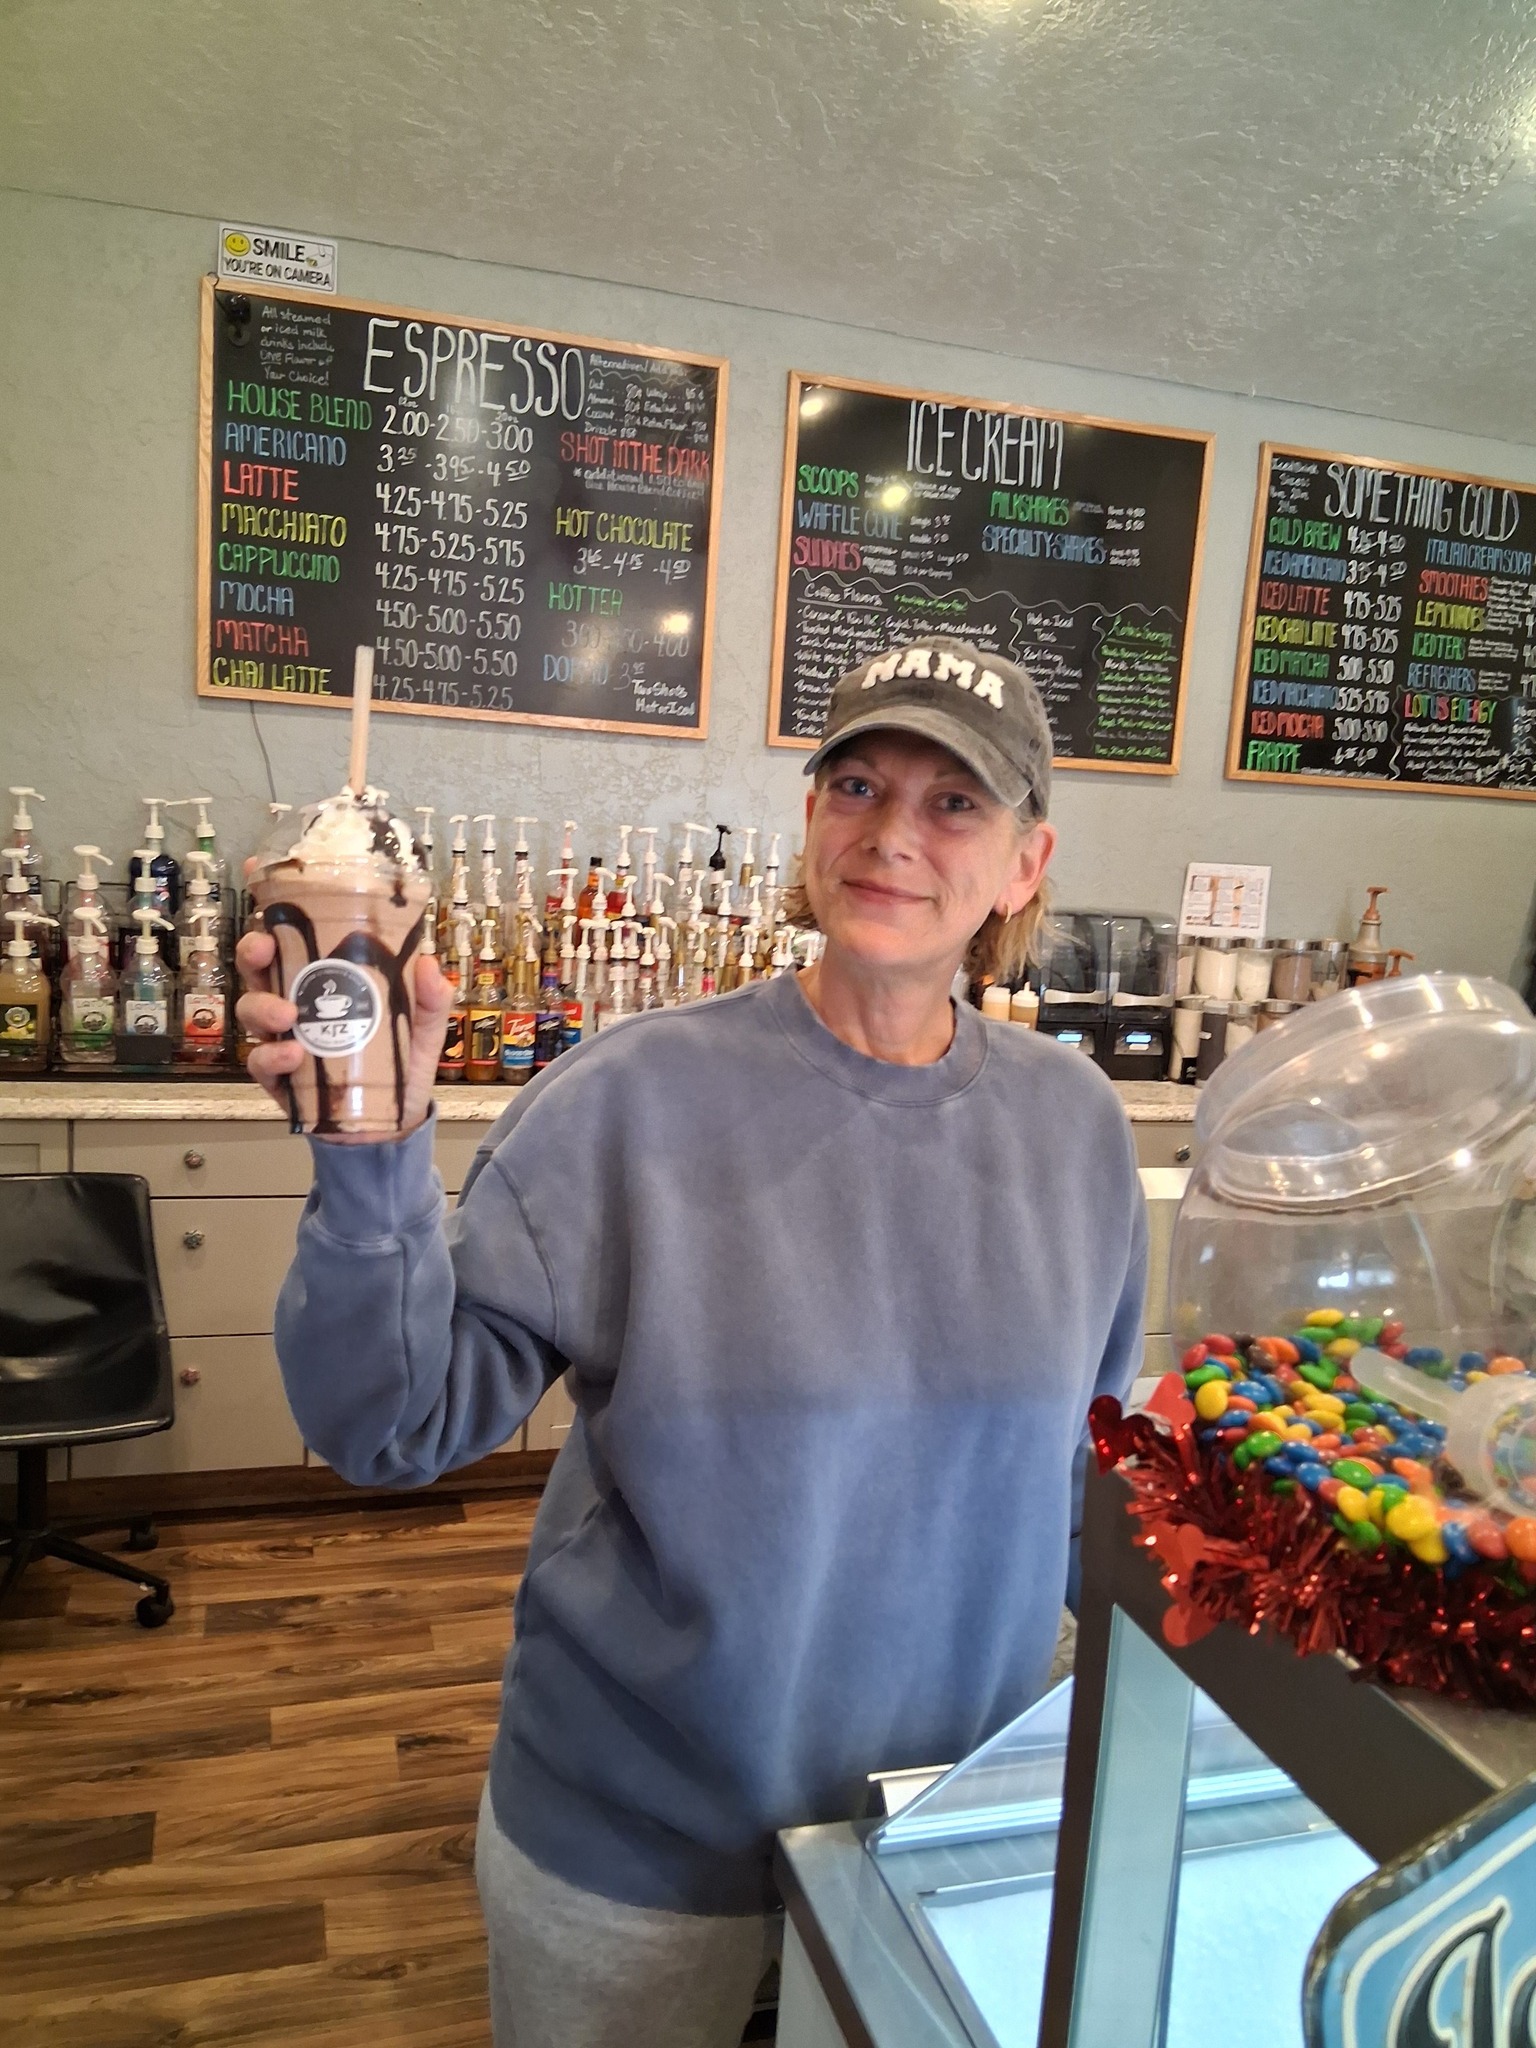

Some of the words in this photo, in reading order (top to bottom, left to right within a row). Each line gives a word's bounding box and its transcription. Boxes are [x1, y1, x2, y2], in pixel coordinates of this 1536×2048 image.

[252, 238, 306, 263] SMILE
[223, 257, 264, 277] YOU'RE
[265, 263, 283, 279] ON
[284, 266, 332, 287] CAMERA
[260, 325, 273, 333] or
[275, 323, 299, 336] iced
[302, 327, 328, 339] milk
[261, 305, 278, 319] All
[280, 307, 332, 326] steamed
[260, 336, 295, 350] drinks
[363, 317, 586, 421] ESPRESSO
[227, 379, 303, 421] HOUSE
[309, 392, 373, 431] BLEND
[225, 422, 347, 467] AMERICANO
[560, 431, 609, 465] SHOT
[906, 400, 957, 477] ICE
[961, 408, 1064, 491] CREAM
[223, 461, 300, 502] LATTE
[797, 464, 860, 499] SCOOPS
[797, 499, 861, 536] WAFFLE
[1324, 461, 1454, 533] SOMETHING
[1459, 483, 1520, 543] COLD
[221, 502, 348, 548] MACCHIATO
[555, 507, 595, 539] HOT
[596, 512, 694, 553] CHOCOLATE
[1268, 516, 1303, 546] COLD
[1302, 520, 1343, 551] BREW
[219, 542, 341, 583] CAPPUCCINO
[1425, 538, 1468, 567] ITALIAN
[1467, 544, 1502, 572] CREAM
[1502, 549, 1533, 576] SODA
[219, 580, 295, 618] MOCHA
[548, 581, 587, 612] HOT
[588, 586, 624, 617] TEA
[1260, 581, 1288, 611] ICED
[1287, 583, 1332, 616] LATTE
[1419, 569, 1490, 602] SMOOTHIES
[216, 619, 309, 657] MATCHA
[212, 656, 265, 689] CHAI
[271, 663, 333, 696] LATTE
[861, 649, 1005, 711] MAMA
[1407, 661, 1477, 693] REFRESHERS
[1404, 693, 1451, 721] LOTUS
[1450, 696, 1499, 724] ENERGY
